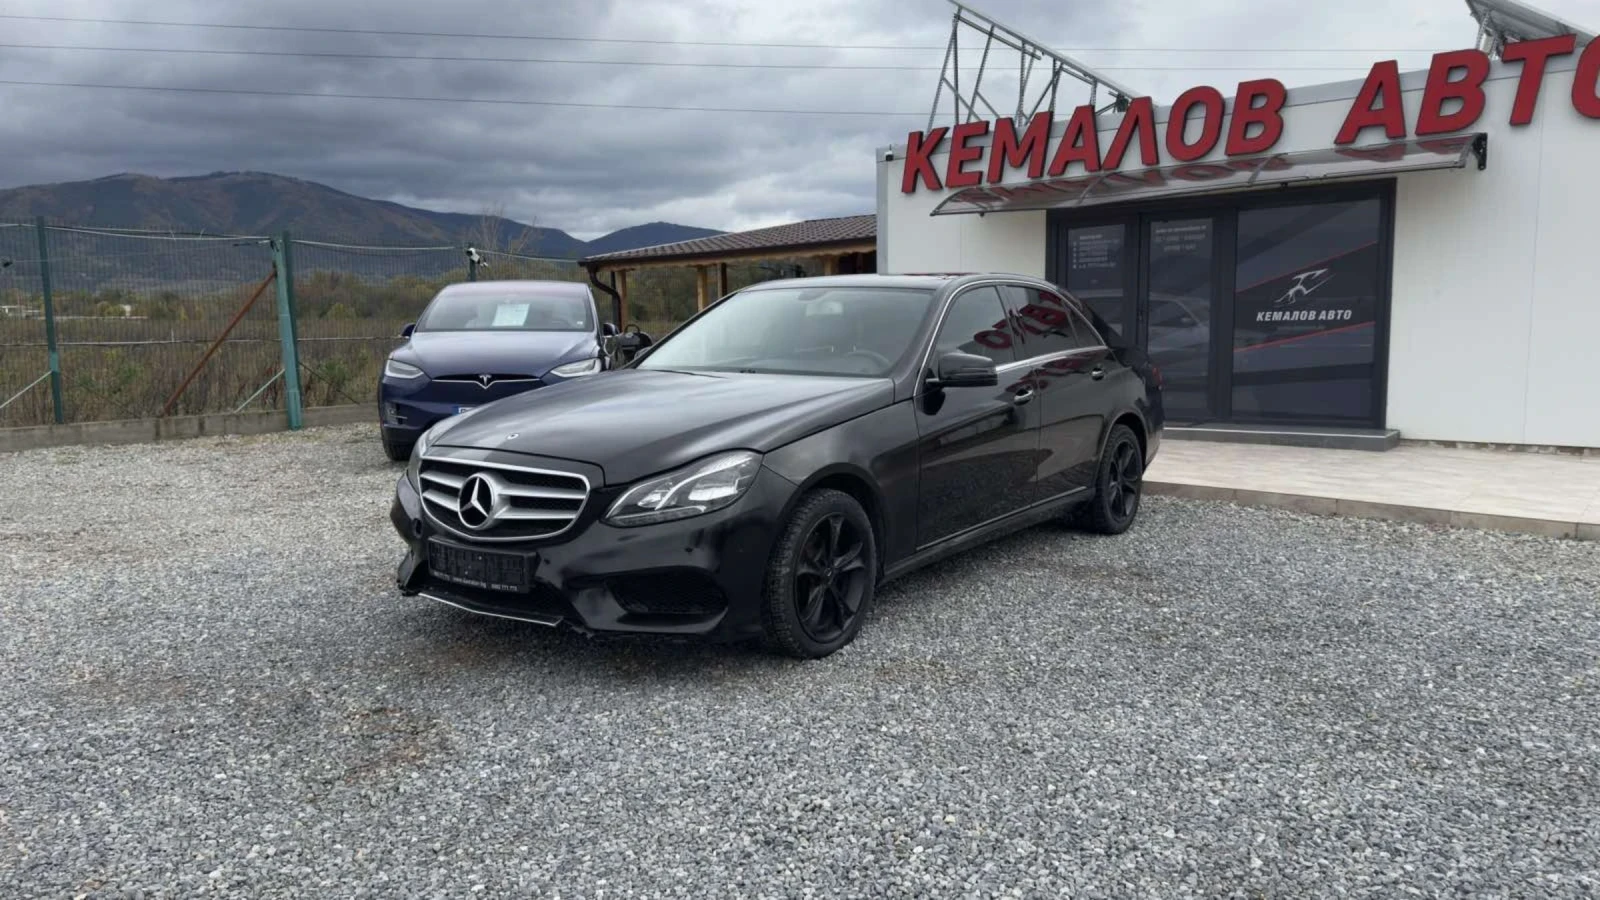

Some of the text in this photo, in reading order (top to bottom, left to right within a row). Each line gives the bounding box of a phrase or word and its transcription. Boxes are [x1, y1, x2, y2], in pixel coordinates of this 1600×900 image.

[902, 80, 1284, 193] КЕМАЛОВ
[1256, 309, 1353, 322] КЕМАЛОВ АВТО
